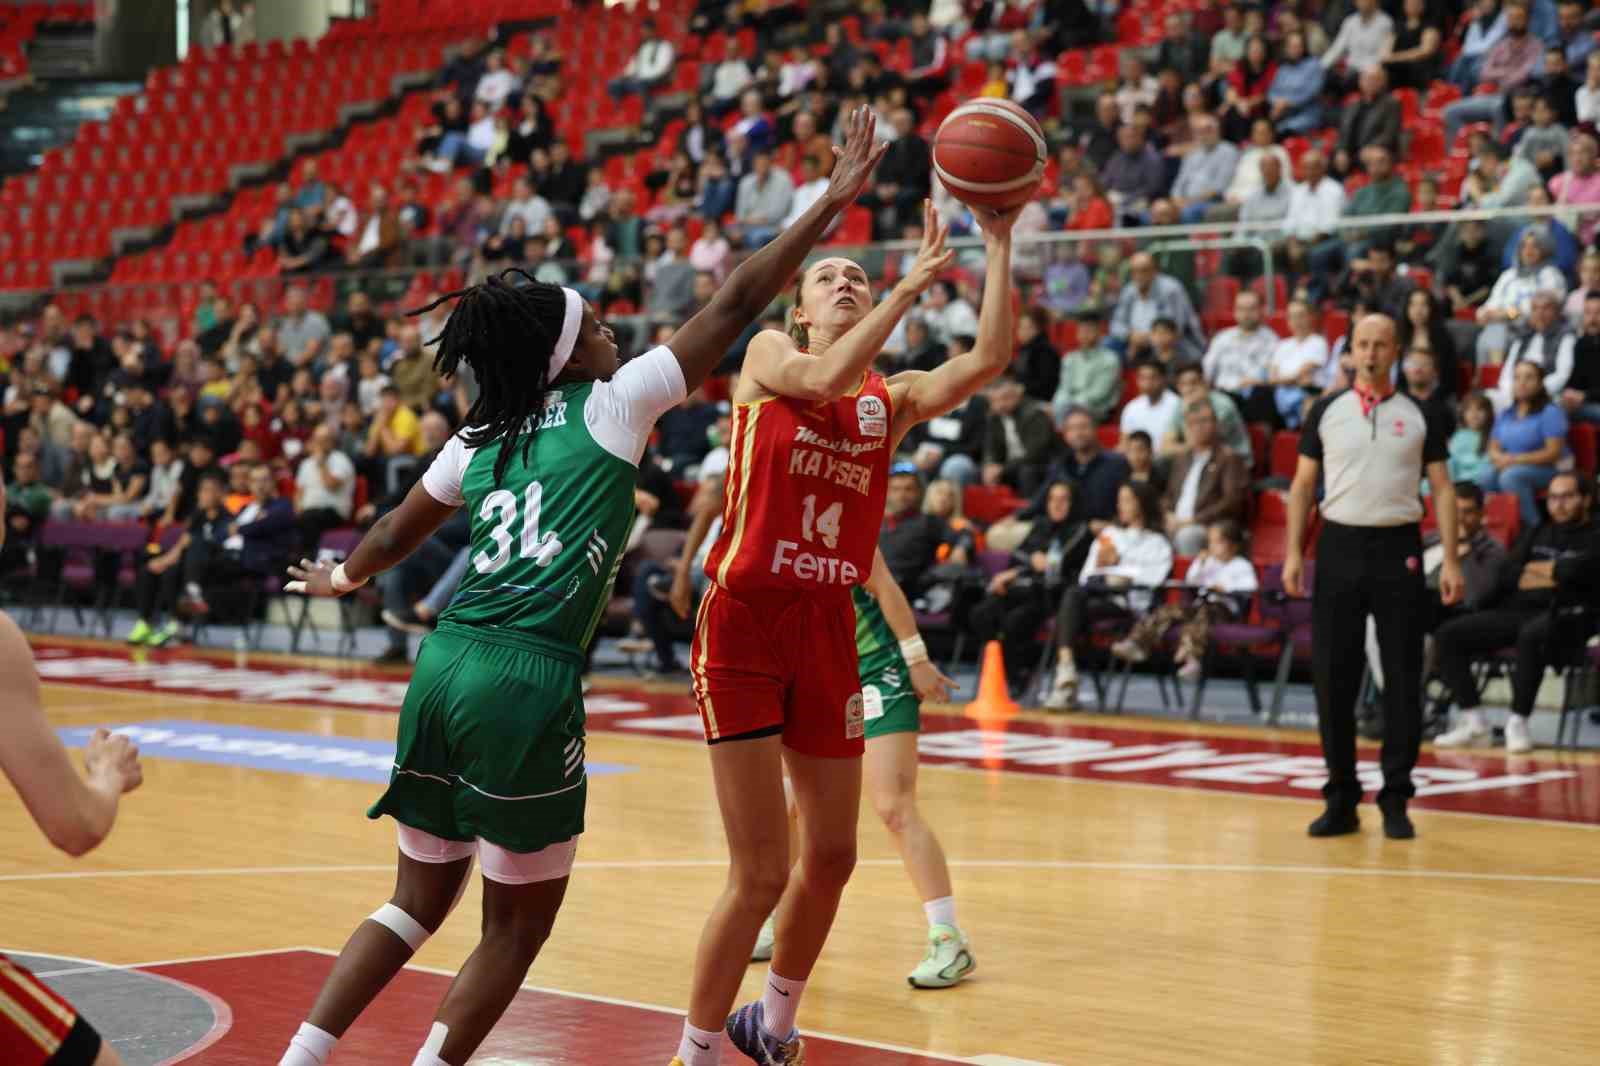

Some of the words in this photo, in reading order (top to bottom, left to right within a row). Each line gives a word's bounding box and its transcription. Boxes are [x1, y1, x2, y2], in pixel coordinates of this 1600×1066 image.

[472, 480, 563, 574] 34
[801, 493, 844, 549] 14
[770, 539, 859, 585] Ferre
